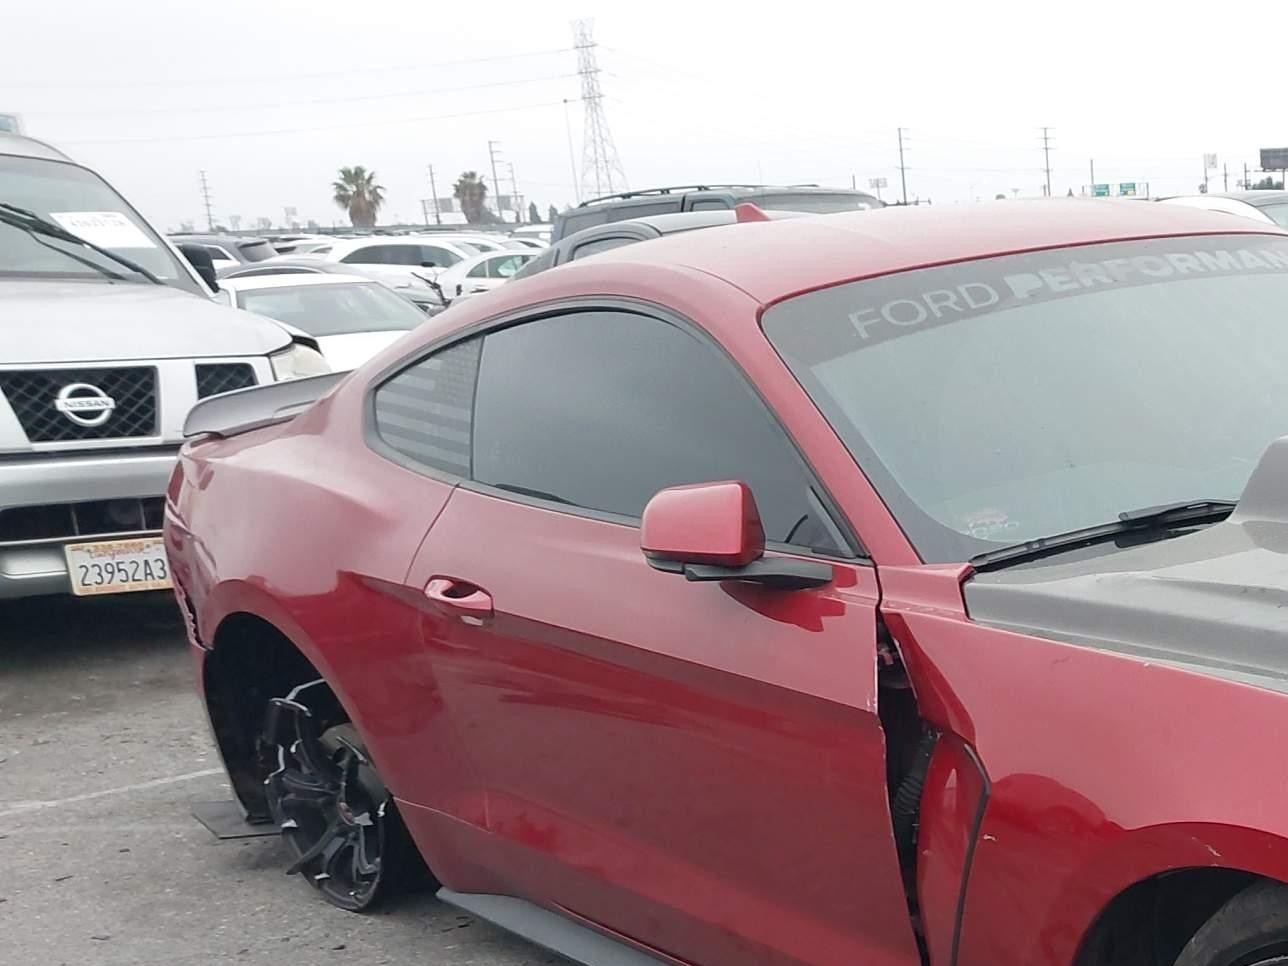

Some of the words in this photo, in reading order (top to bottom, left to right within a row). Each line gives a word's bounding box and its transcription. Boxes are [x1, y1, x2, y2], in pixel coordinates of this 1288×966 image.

[848, 281, 1000, 340] FORD
[63, 400, 110, 409] NISSAN
[78, 558, 168, 587] 23952A3
